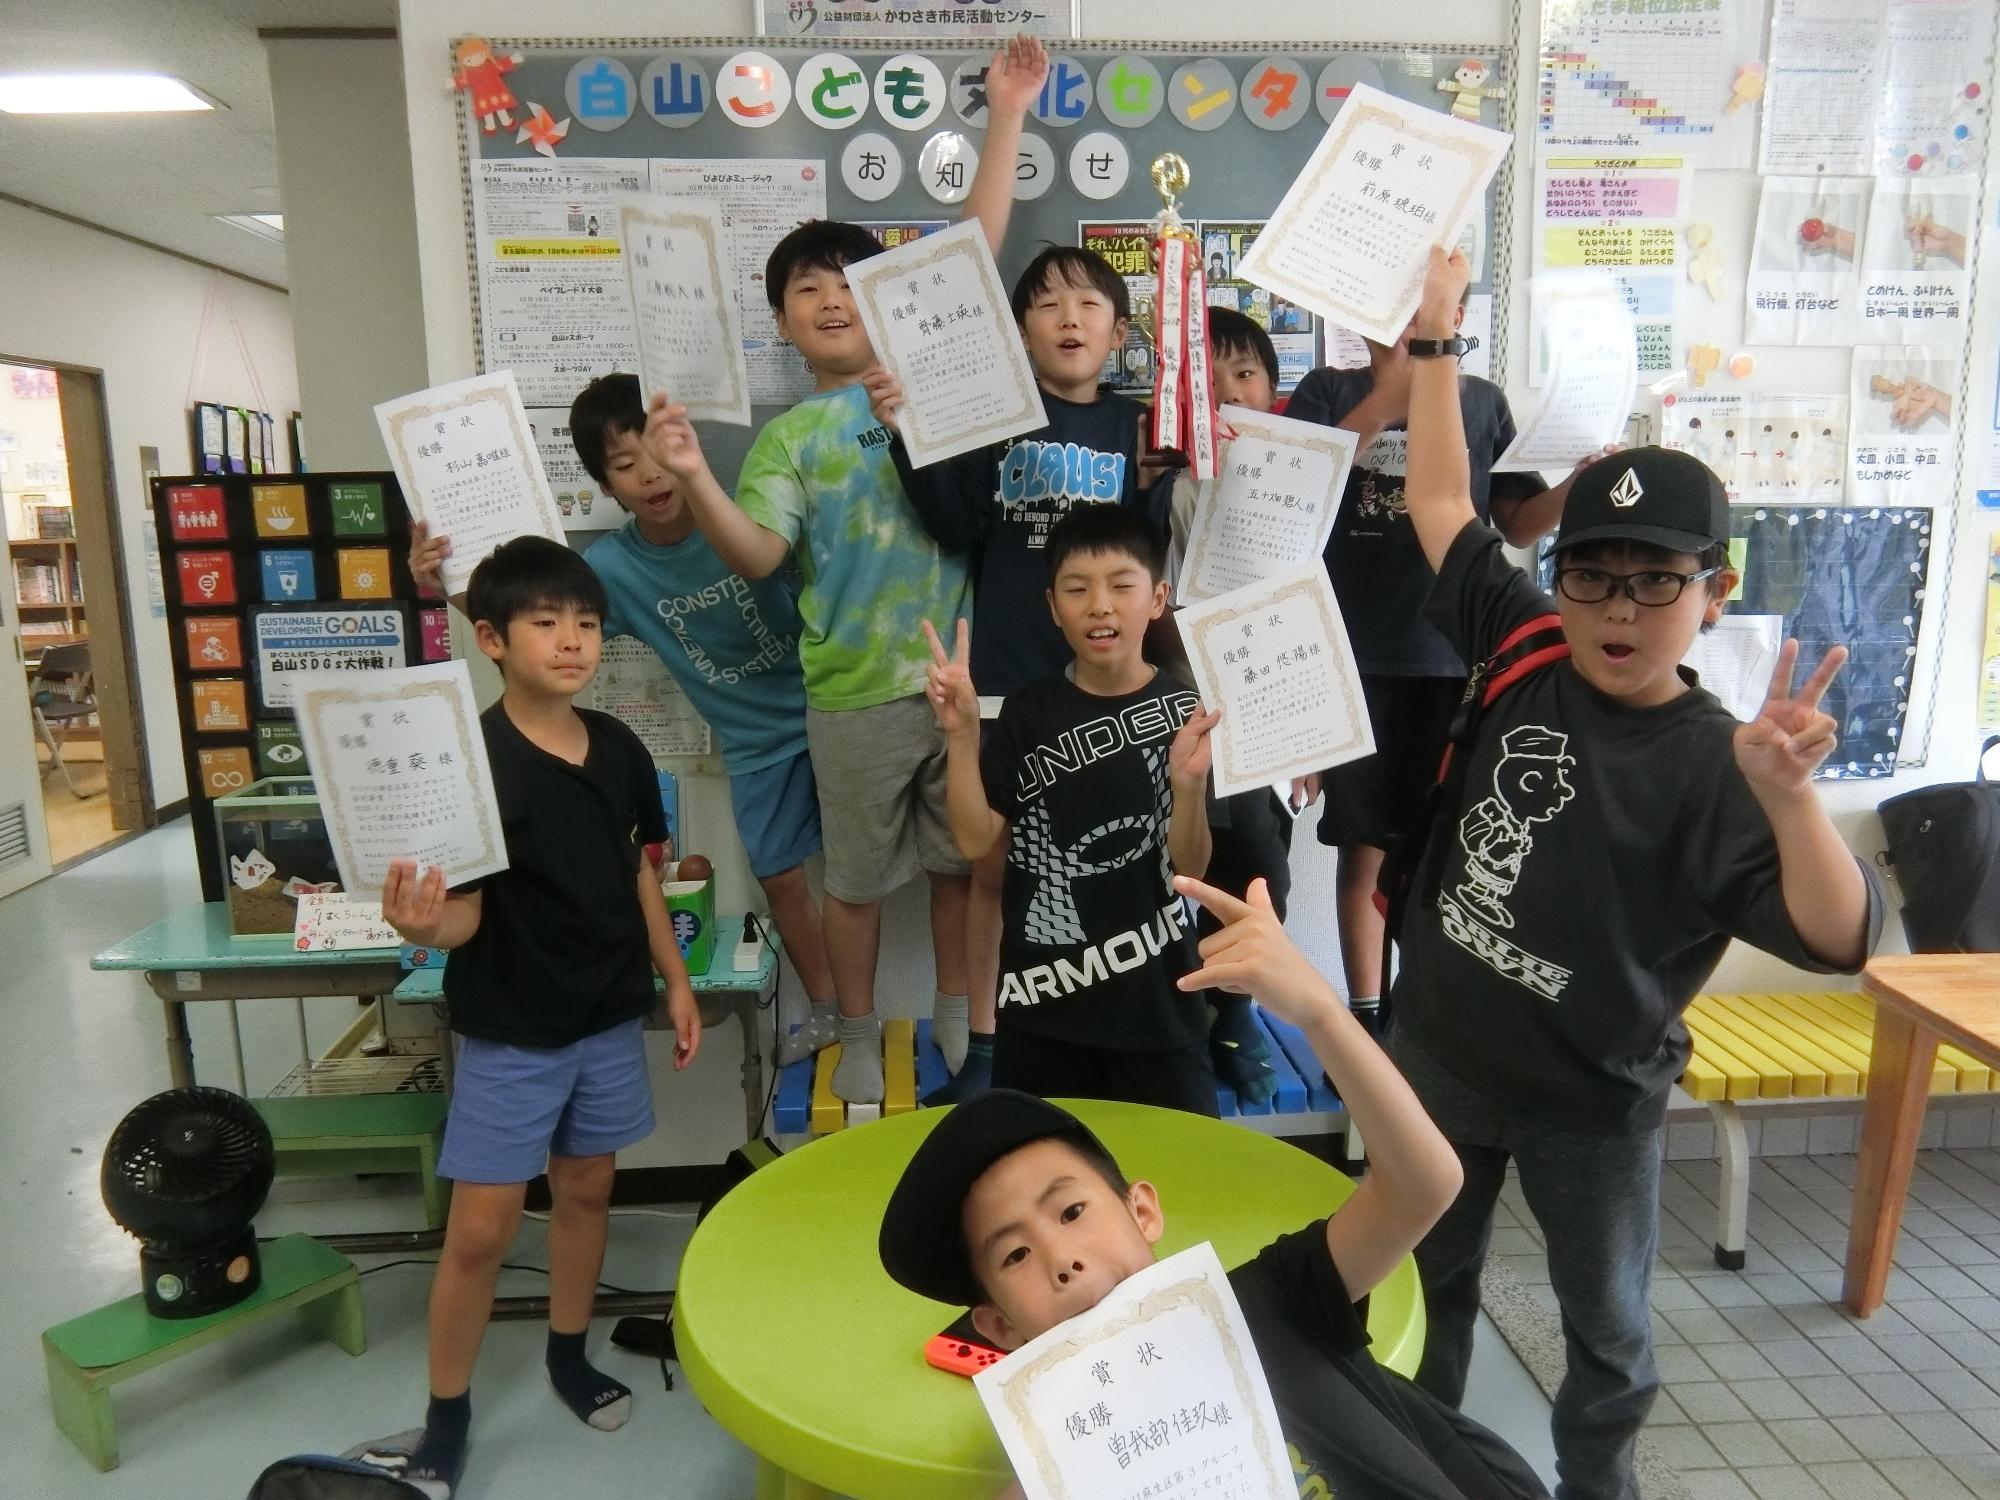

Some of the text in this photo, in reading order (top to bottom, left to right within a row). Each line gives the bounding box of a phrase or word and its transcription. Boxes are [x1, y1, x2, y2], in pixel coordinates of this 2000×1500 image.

[823, 8, 1046, 24] 公益財団法人 かわさき市民活動センター
[1352, 149, 1382, 171] 優勝
[858, 151, 1115, 190] お知らせ
[907, 272, 947, 296] 賞状
[1866, 284, 1955, 297] とめけん、ふりけん
[891, 302, 919, 321] 優勝
[1755, 298, 1840, 310] 飛行機、灯台など
[1865, 306, 1959, 319] 日本一周 世界一周
[433, 415, 475, 434] 賞状
[417, 442, 444, 459] 優勝
[1264, 450, 1303, 470] 賞状
[1855, 453, 1941, 465] 大皿、小皿、中皿、
[1235, 463, 1263, 479] 優勝
[1856, 469, 1913, 481] もしかめなど
[256, 491, 264, 501] 2
[334, 488, 342, 500] 3
[1024, 512, 1050, 522] BEYOND
[182, 558, 190, 569] 5
[265, 555, 272, 567] 6
[189, 622, 197, 633] 9
[259, 615, 396, 634] SUSTAINABLE GOALS
[424, 615, 435, 625] 10
[1241, 614, 1283, 638] 賞状
[260, 626, 323, 636] DEVELOPMENT
[721, 633, 796, 685] SYSTEM
[1223, 645, 1251, 665] 優勝
[260, 727, 272, 738] 13
[1016, 690, 1200, 802] UNDER
[201, 754, 212, 765] 12
[998, 895, 1191, 1009] ARMOUR
[1090, 1341, 1164, 1388] 賞状
[1064, 1402, 1113, 1442] 優勝
